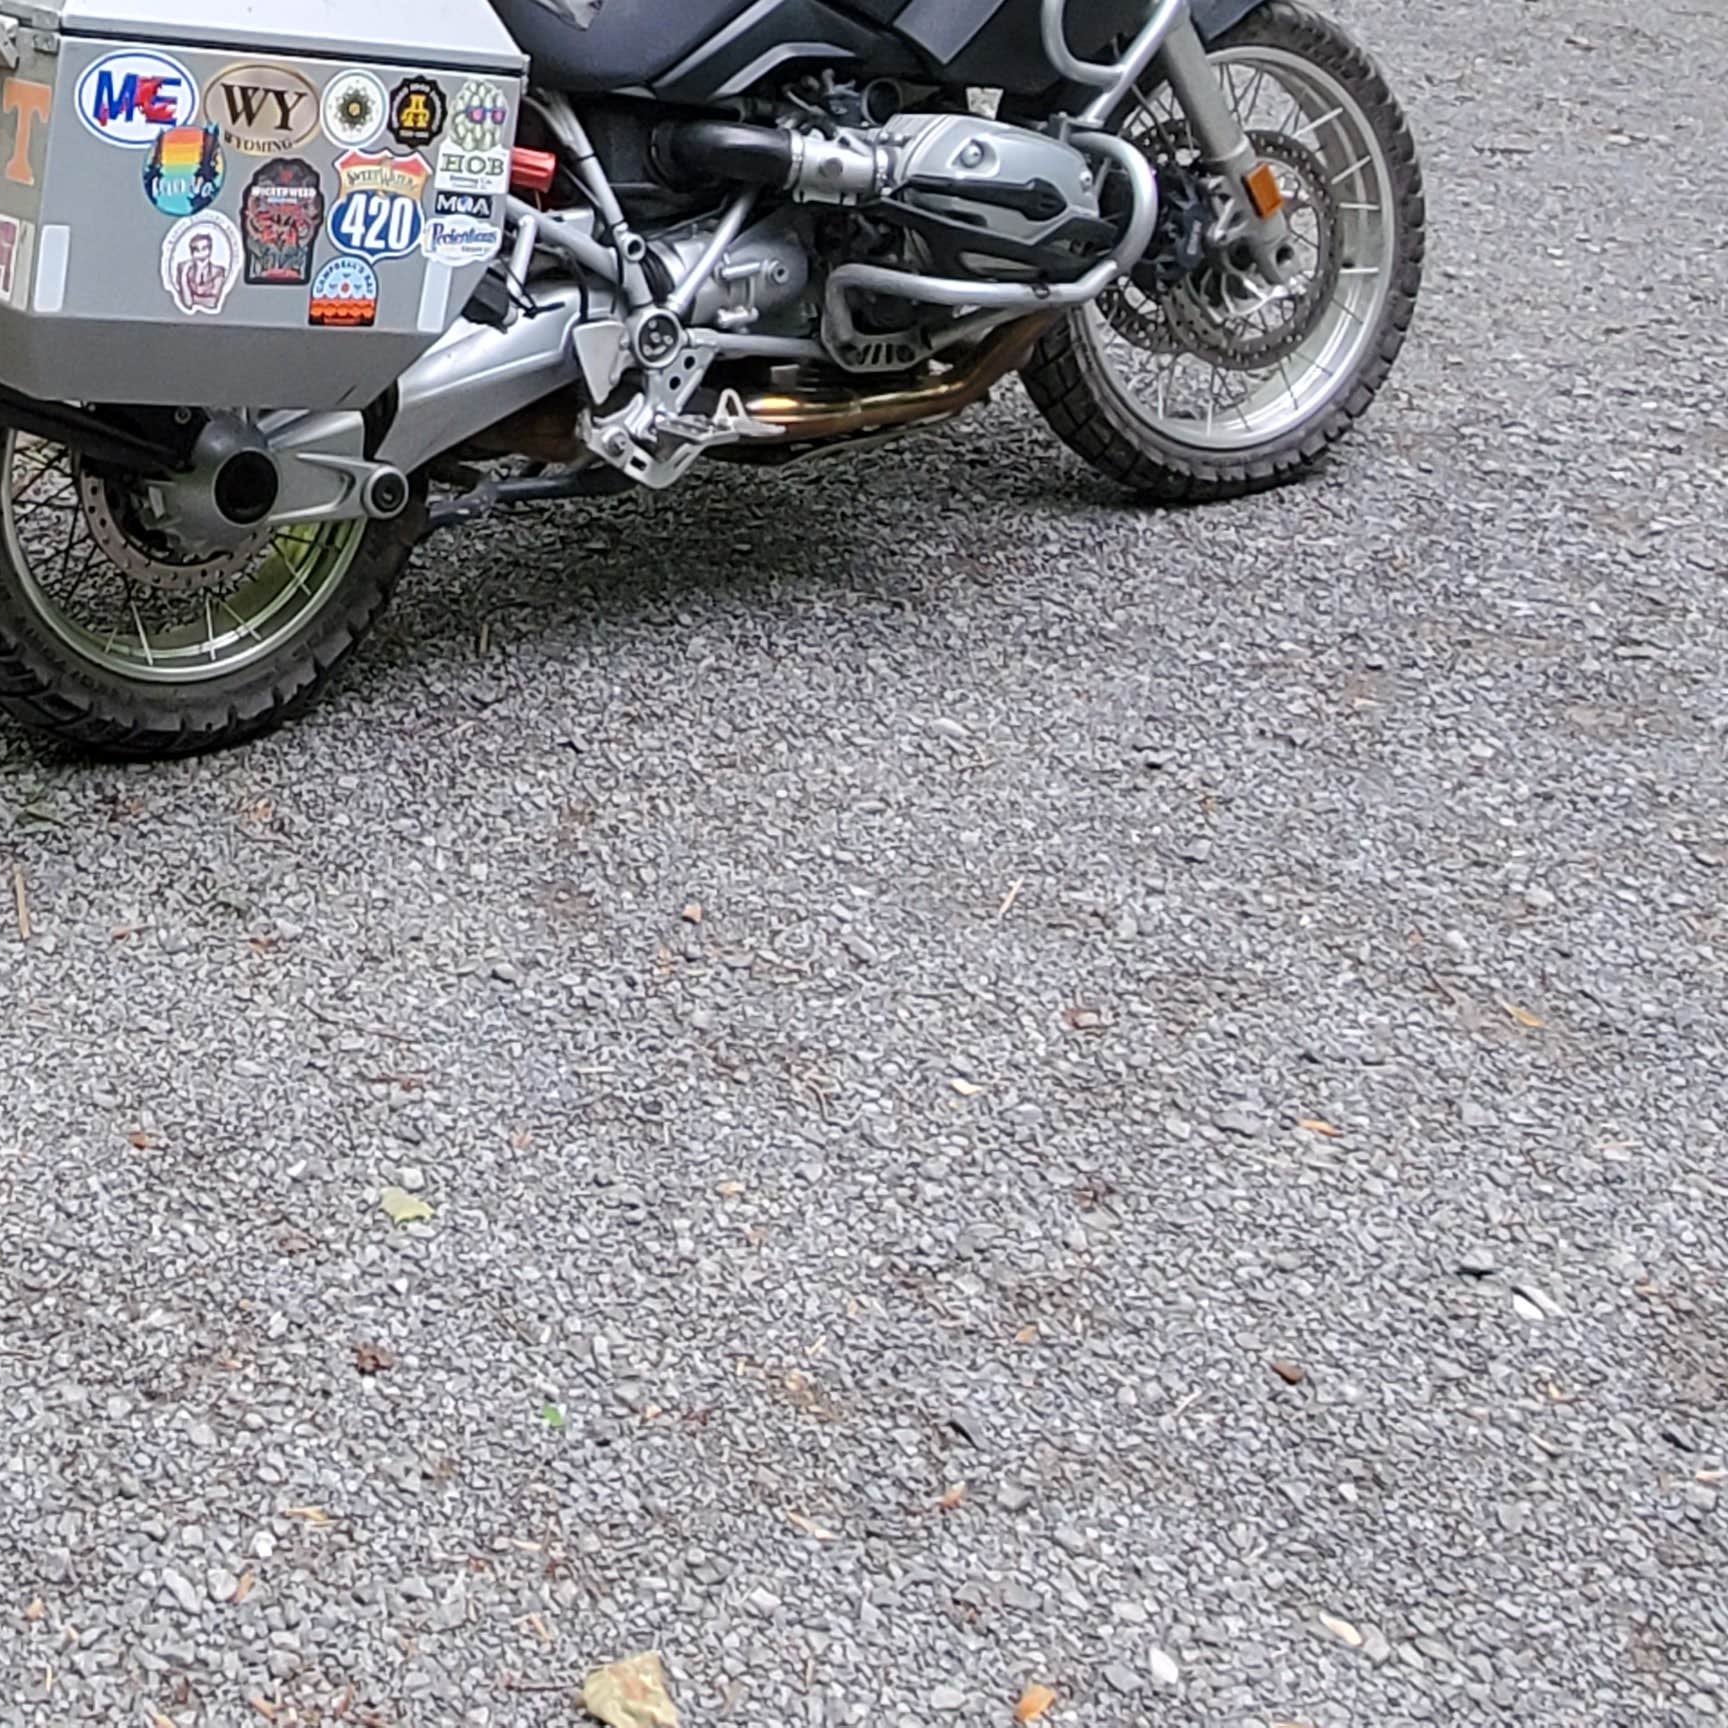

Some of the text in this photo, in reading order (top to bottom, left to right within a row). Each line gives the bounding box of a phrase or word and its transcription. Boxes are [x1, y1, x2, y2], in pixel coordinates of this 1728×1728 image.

[93, 70, 182, 127] ME
[220, 83, 308, 132] WY
[3, 77, 52, 186] T
[224, 129, 294, 153] WYOMING
[439, 153, 504, 177] HOB
[340, 193, 414, 250] 420
